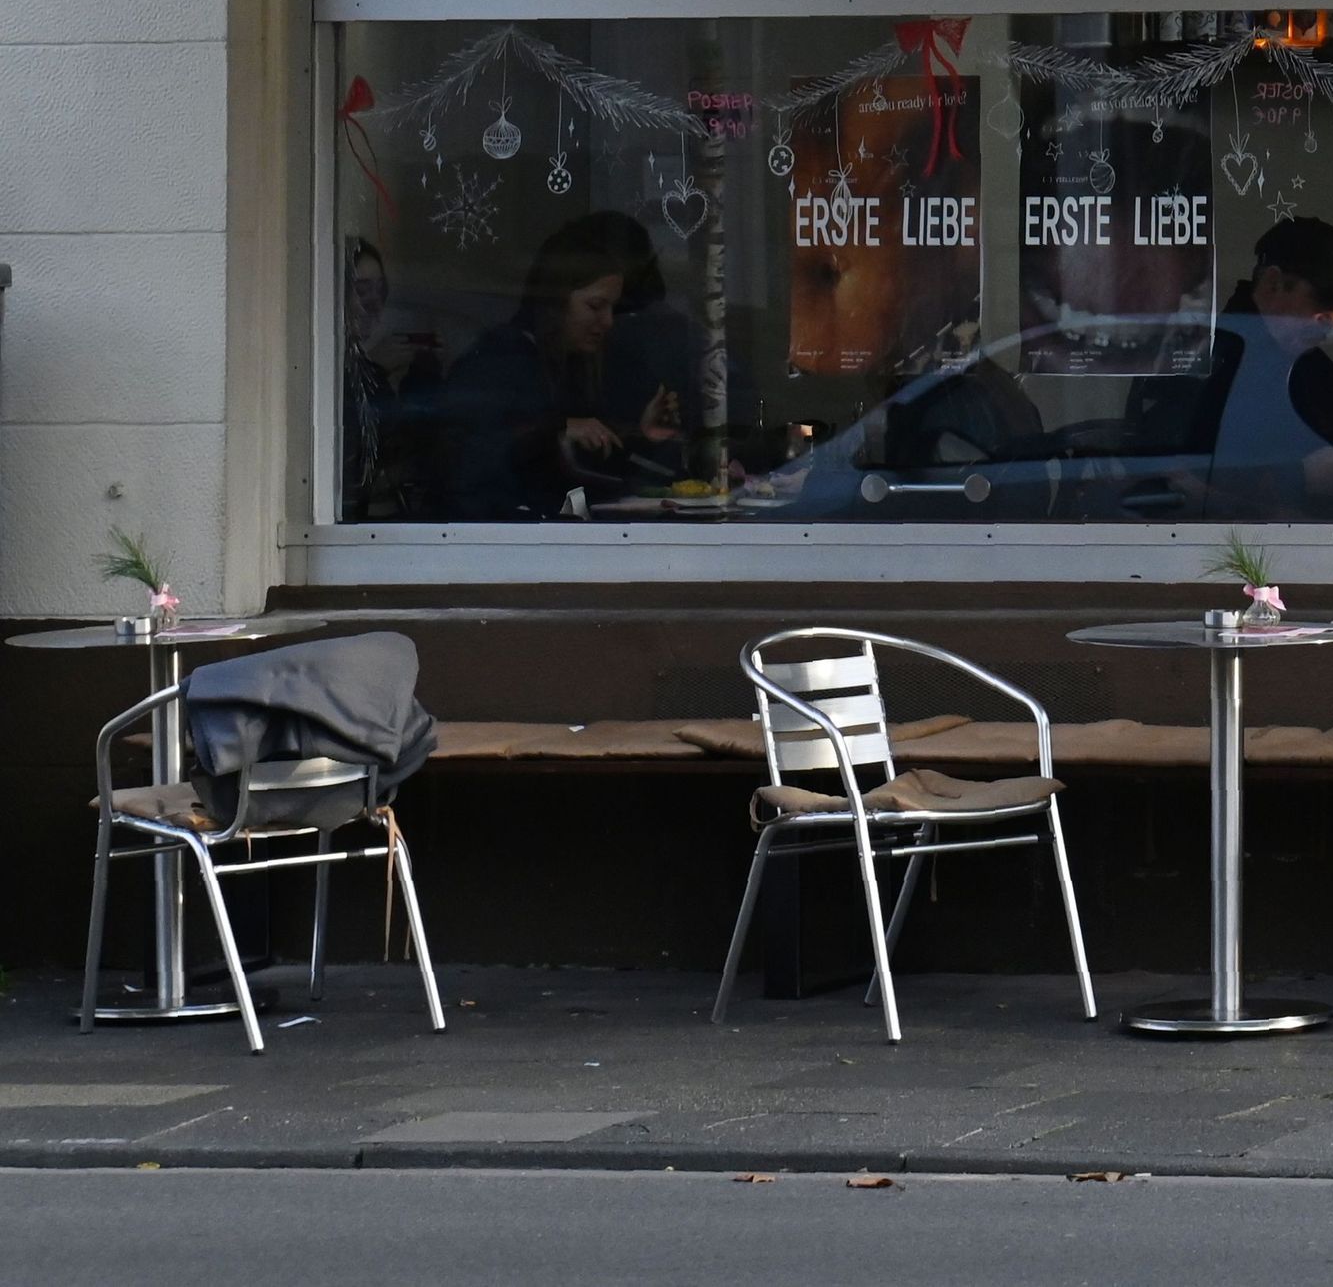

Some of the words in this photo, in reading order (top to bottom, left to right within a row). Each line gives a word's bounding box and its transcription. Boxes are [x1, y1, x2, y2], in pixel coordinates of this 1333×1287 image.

[796, 197, 880, 247] ERSTE
[903, 196, 975, 247] LIEBE
[1025, 195, 1112, 246] ERSTE
[1133, 195, 1208, 246] LIEBE
